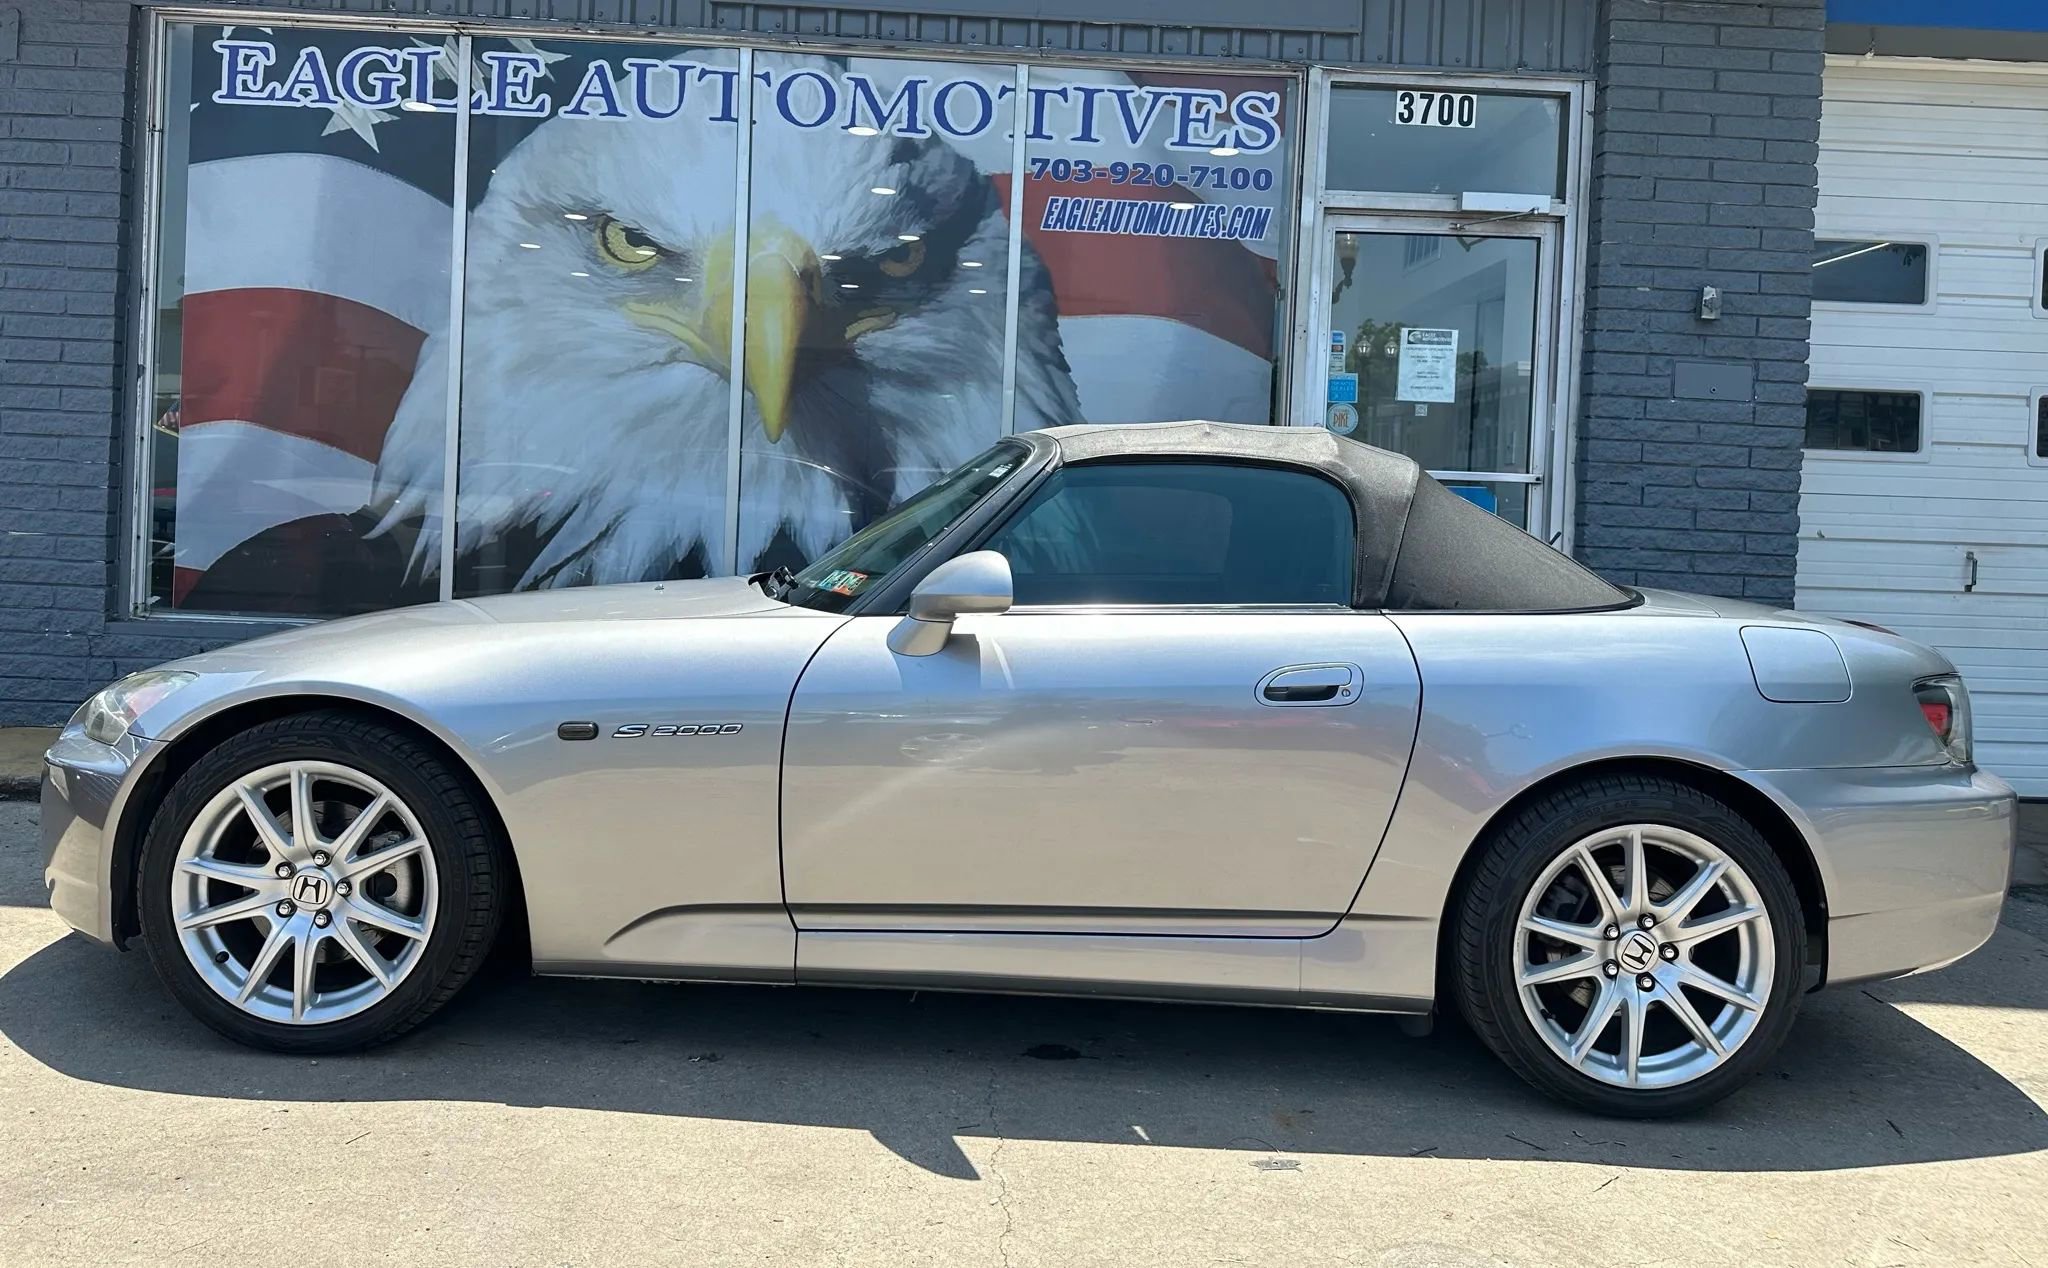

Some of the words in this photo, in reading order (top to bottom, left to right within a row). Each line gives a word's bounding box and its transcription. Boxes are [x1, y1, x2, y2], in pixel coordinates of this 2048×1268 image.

[214, 41, 549, 116] EAGLE
[560, 58, 1280, 152] AUTOMOTIVES
[1398, 91, 1475, 127] 3700
[1031, 157, 1273, 191] 703-920-7100
[1040, 196, 1273, 241] EAGLEAUTOMOTIVES.COM
